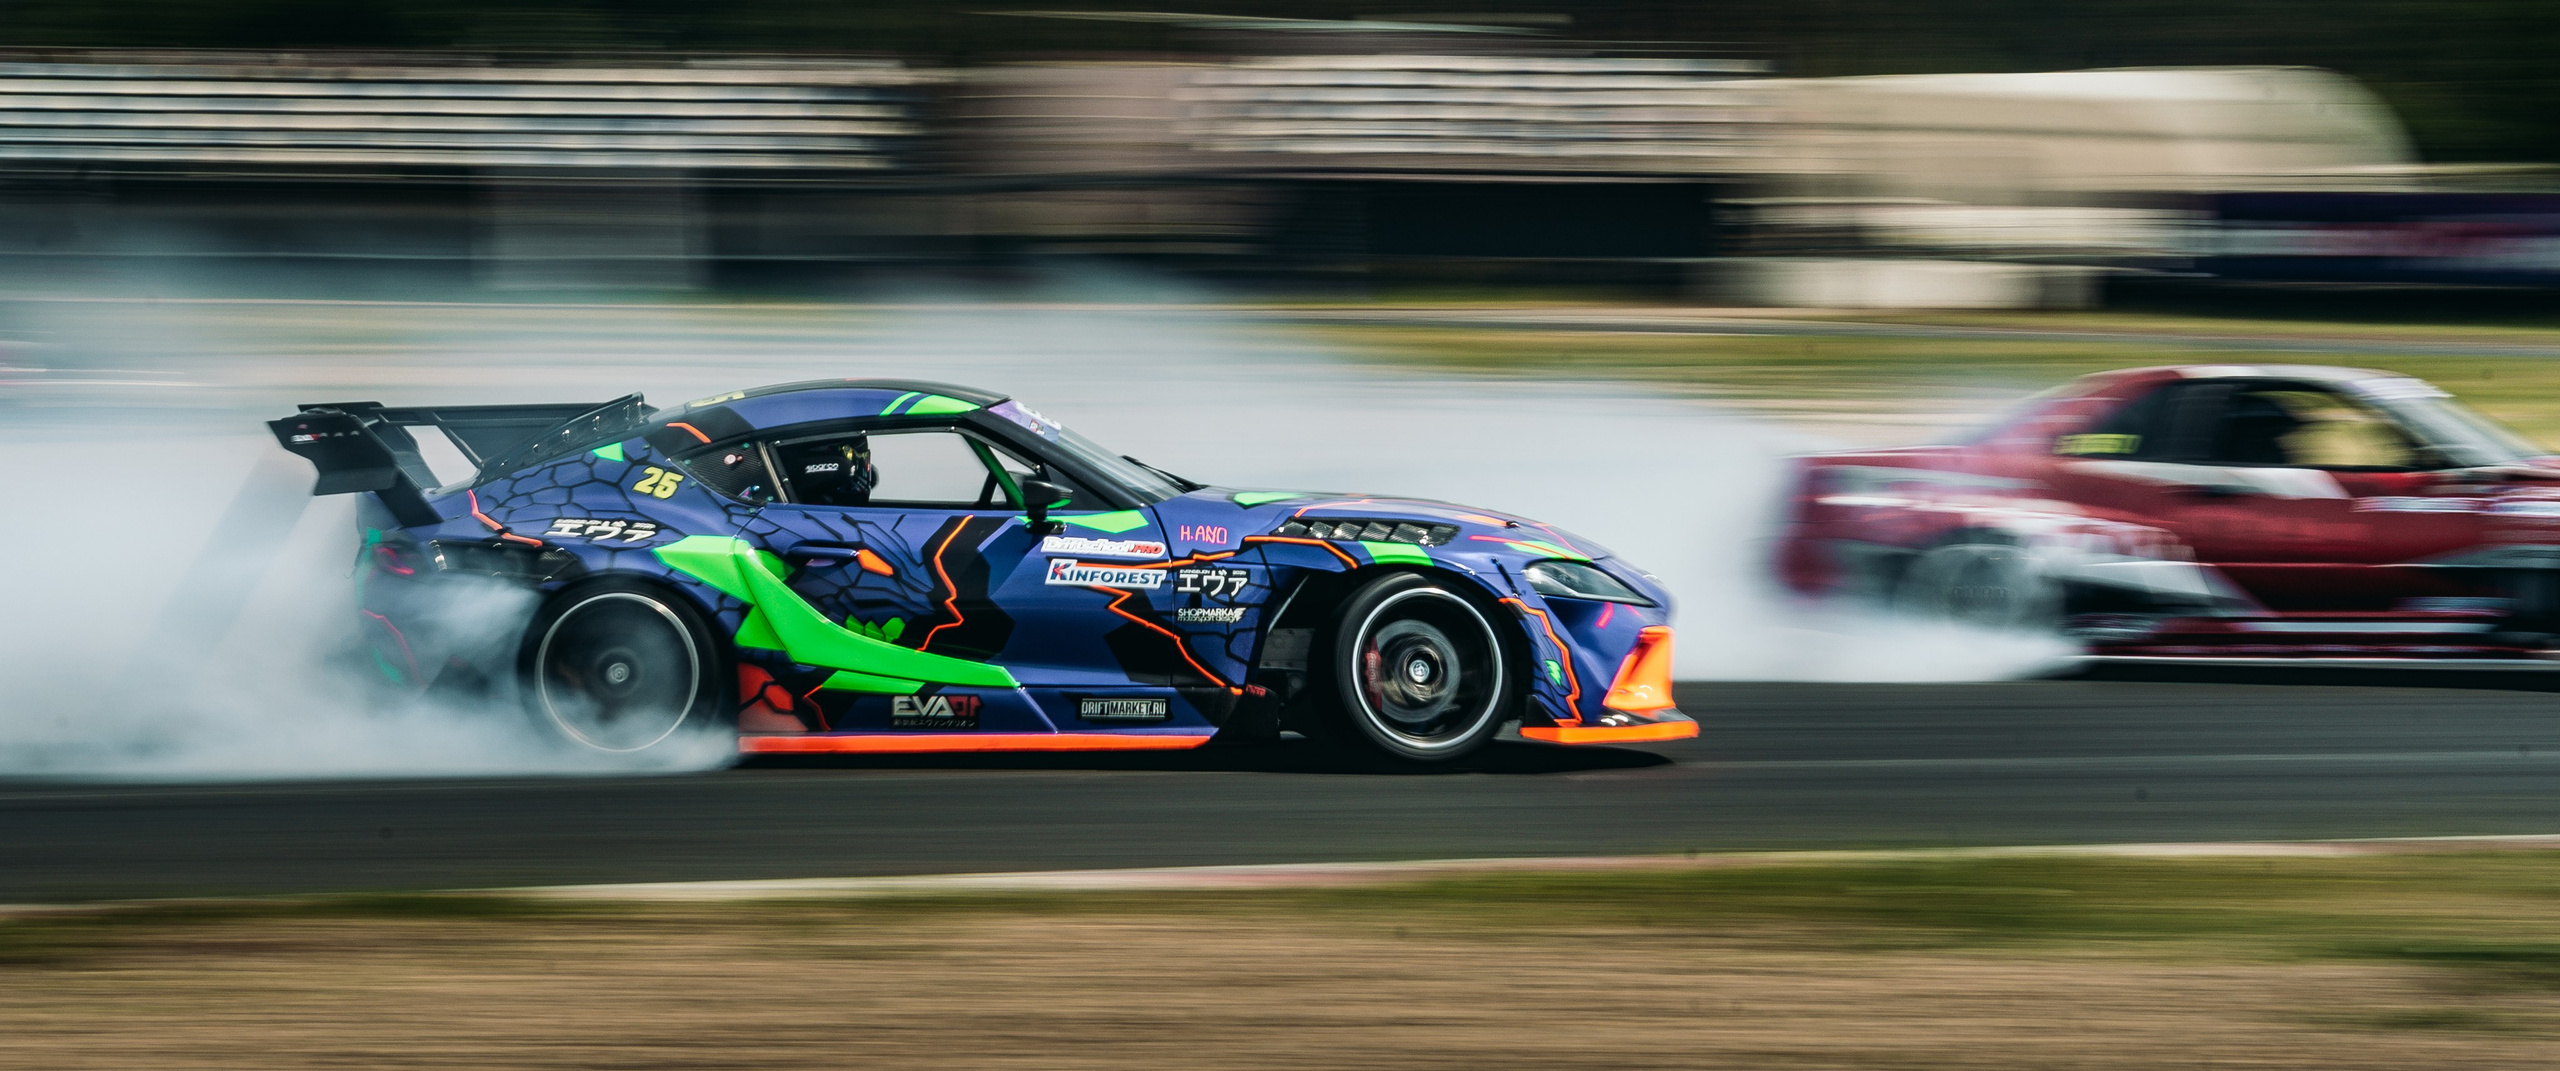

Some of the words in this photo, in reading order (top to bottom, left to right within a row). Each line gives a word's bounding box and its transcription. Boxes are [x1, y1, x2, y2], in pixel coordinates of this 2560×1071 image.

[805, 463, 839, 474] sparco
[632, 466, 684, 499] 25
[543, 519, 656, 544] エヴァ
[1050, 562, 1163, 585] KINFOREST
[1177, 569, 1248, 597] エヴァ
[1178, 607, 1235, 617] SHOPMARKA
[1081, 701, 1166, 715] DRIFTMARKET.RU
